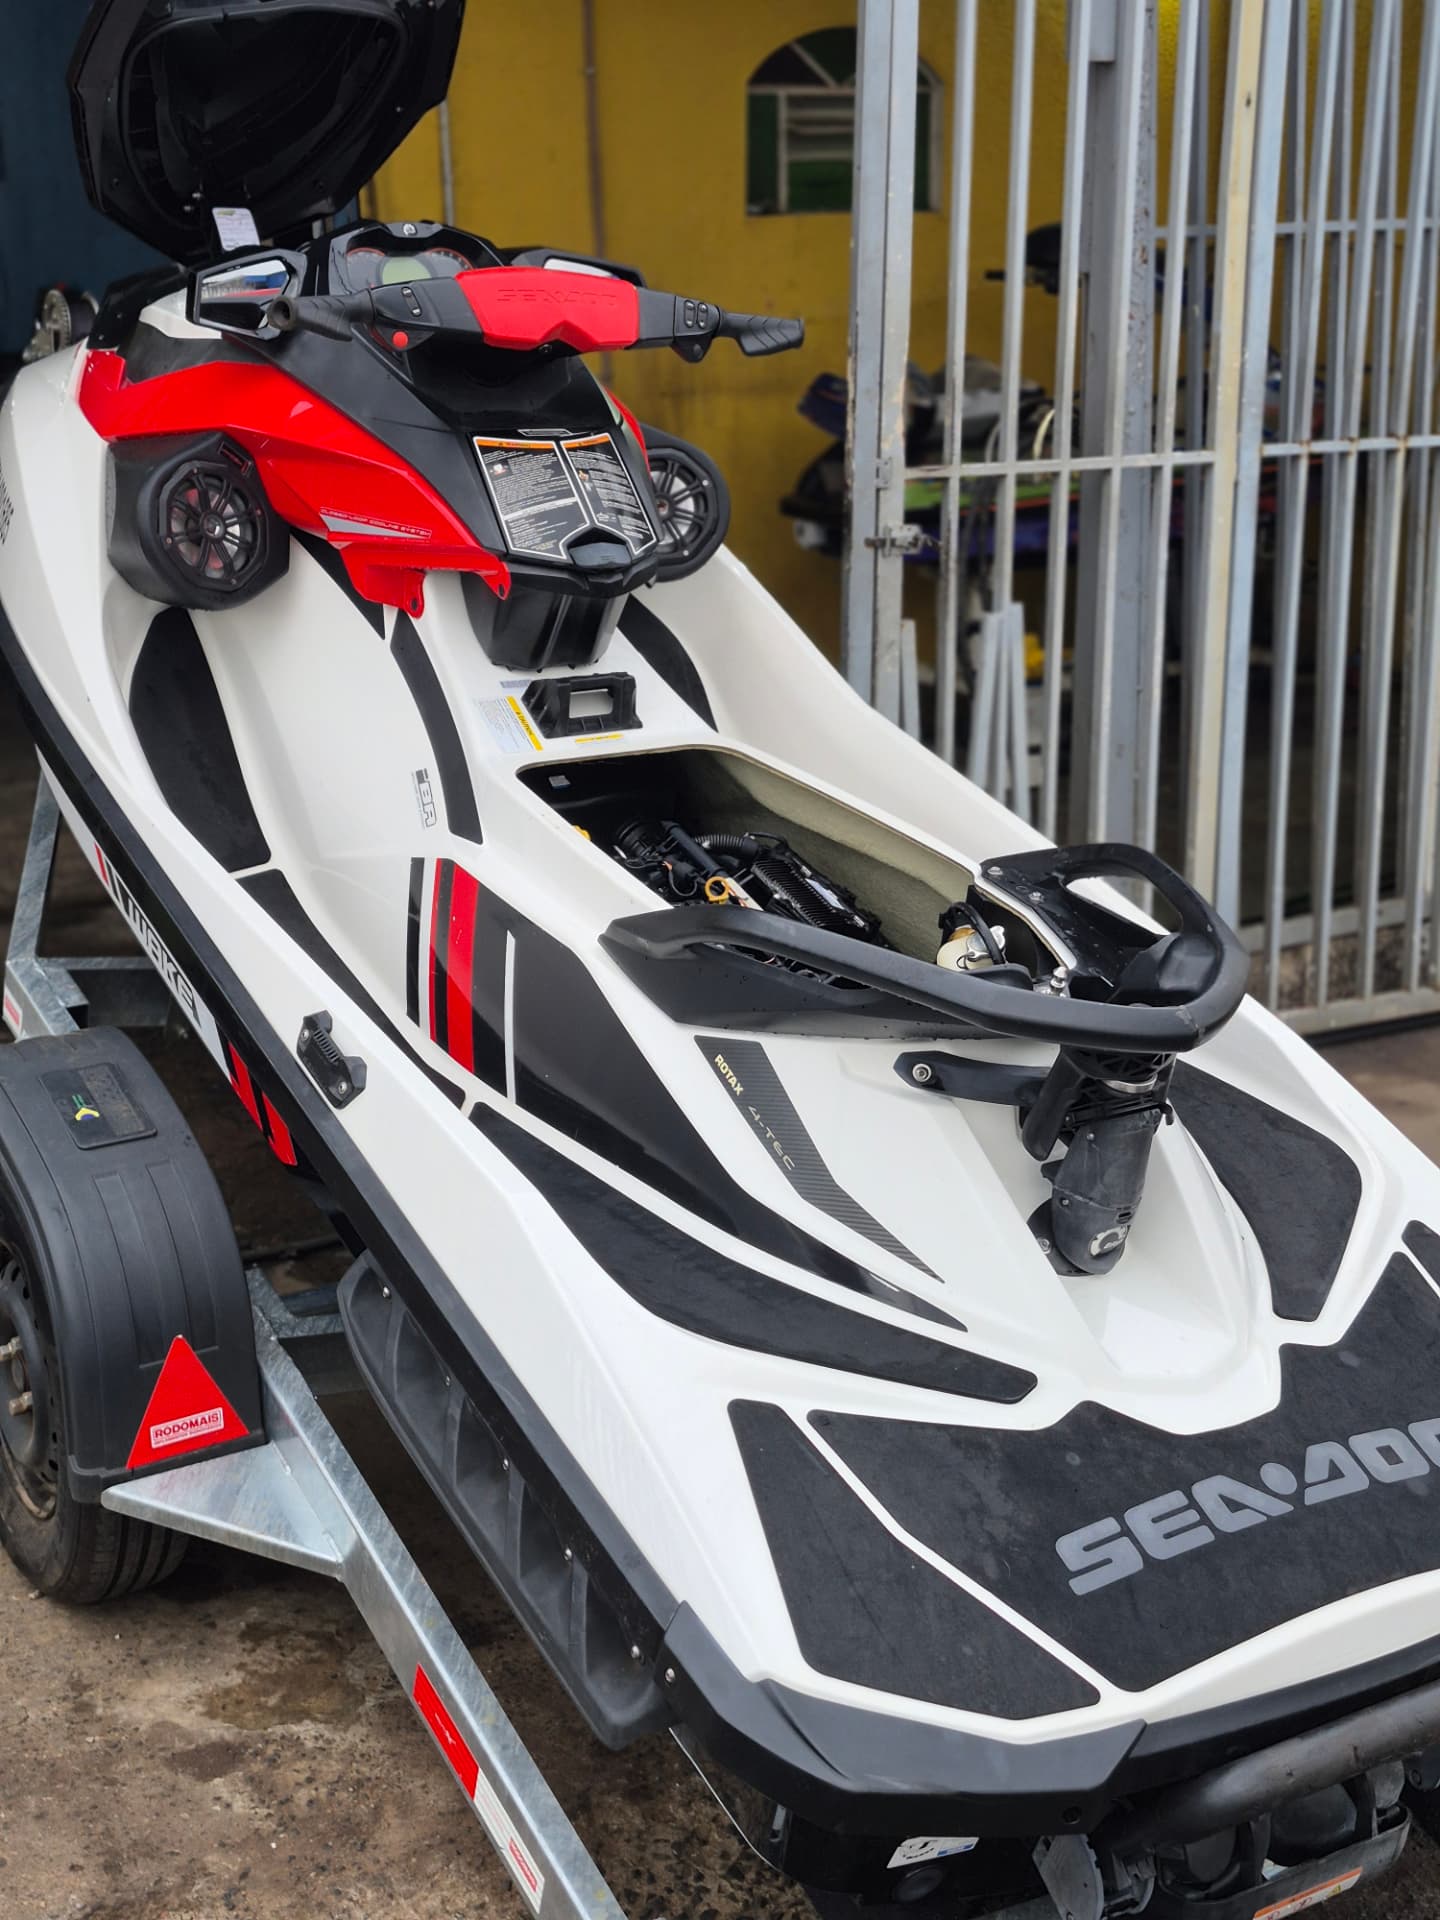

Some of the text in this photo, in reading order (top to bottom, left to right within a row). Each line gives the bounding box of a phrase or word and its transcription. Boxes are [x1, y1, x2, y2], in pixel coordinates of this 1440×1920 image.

[126, 895, 196, 1013] WAKE
[714, 1053, 744, 1096] ROTAX
[748, 1105, 795, 1171] 4-TEC
[155, 1413, 219, 1438] RODOMAIS
